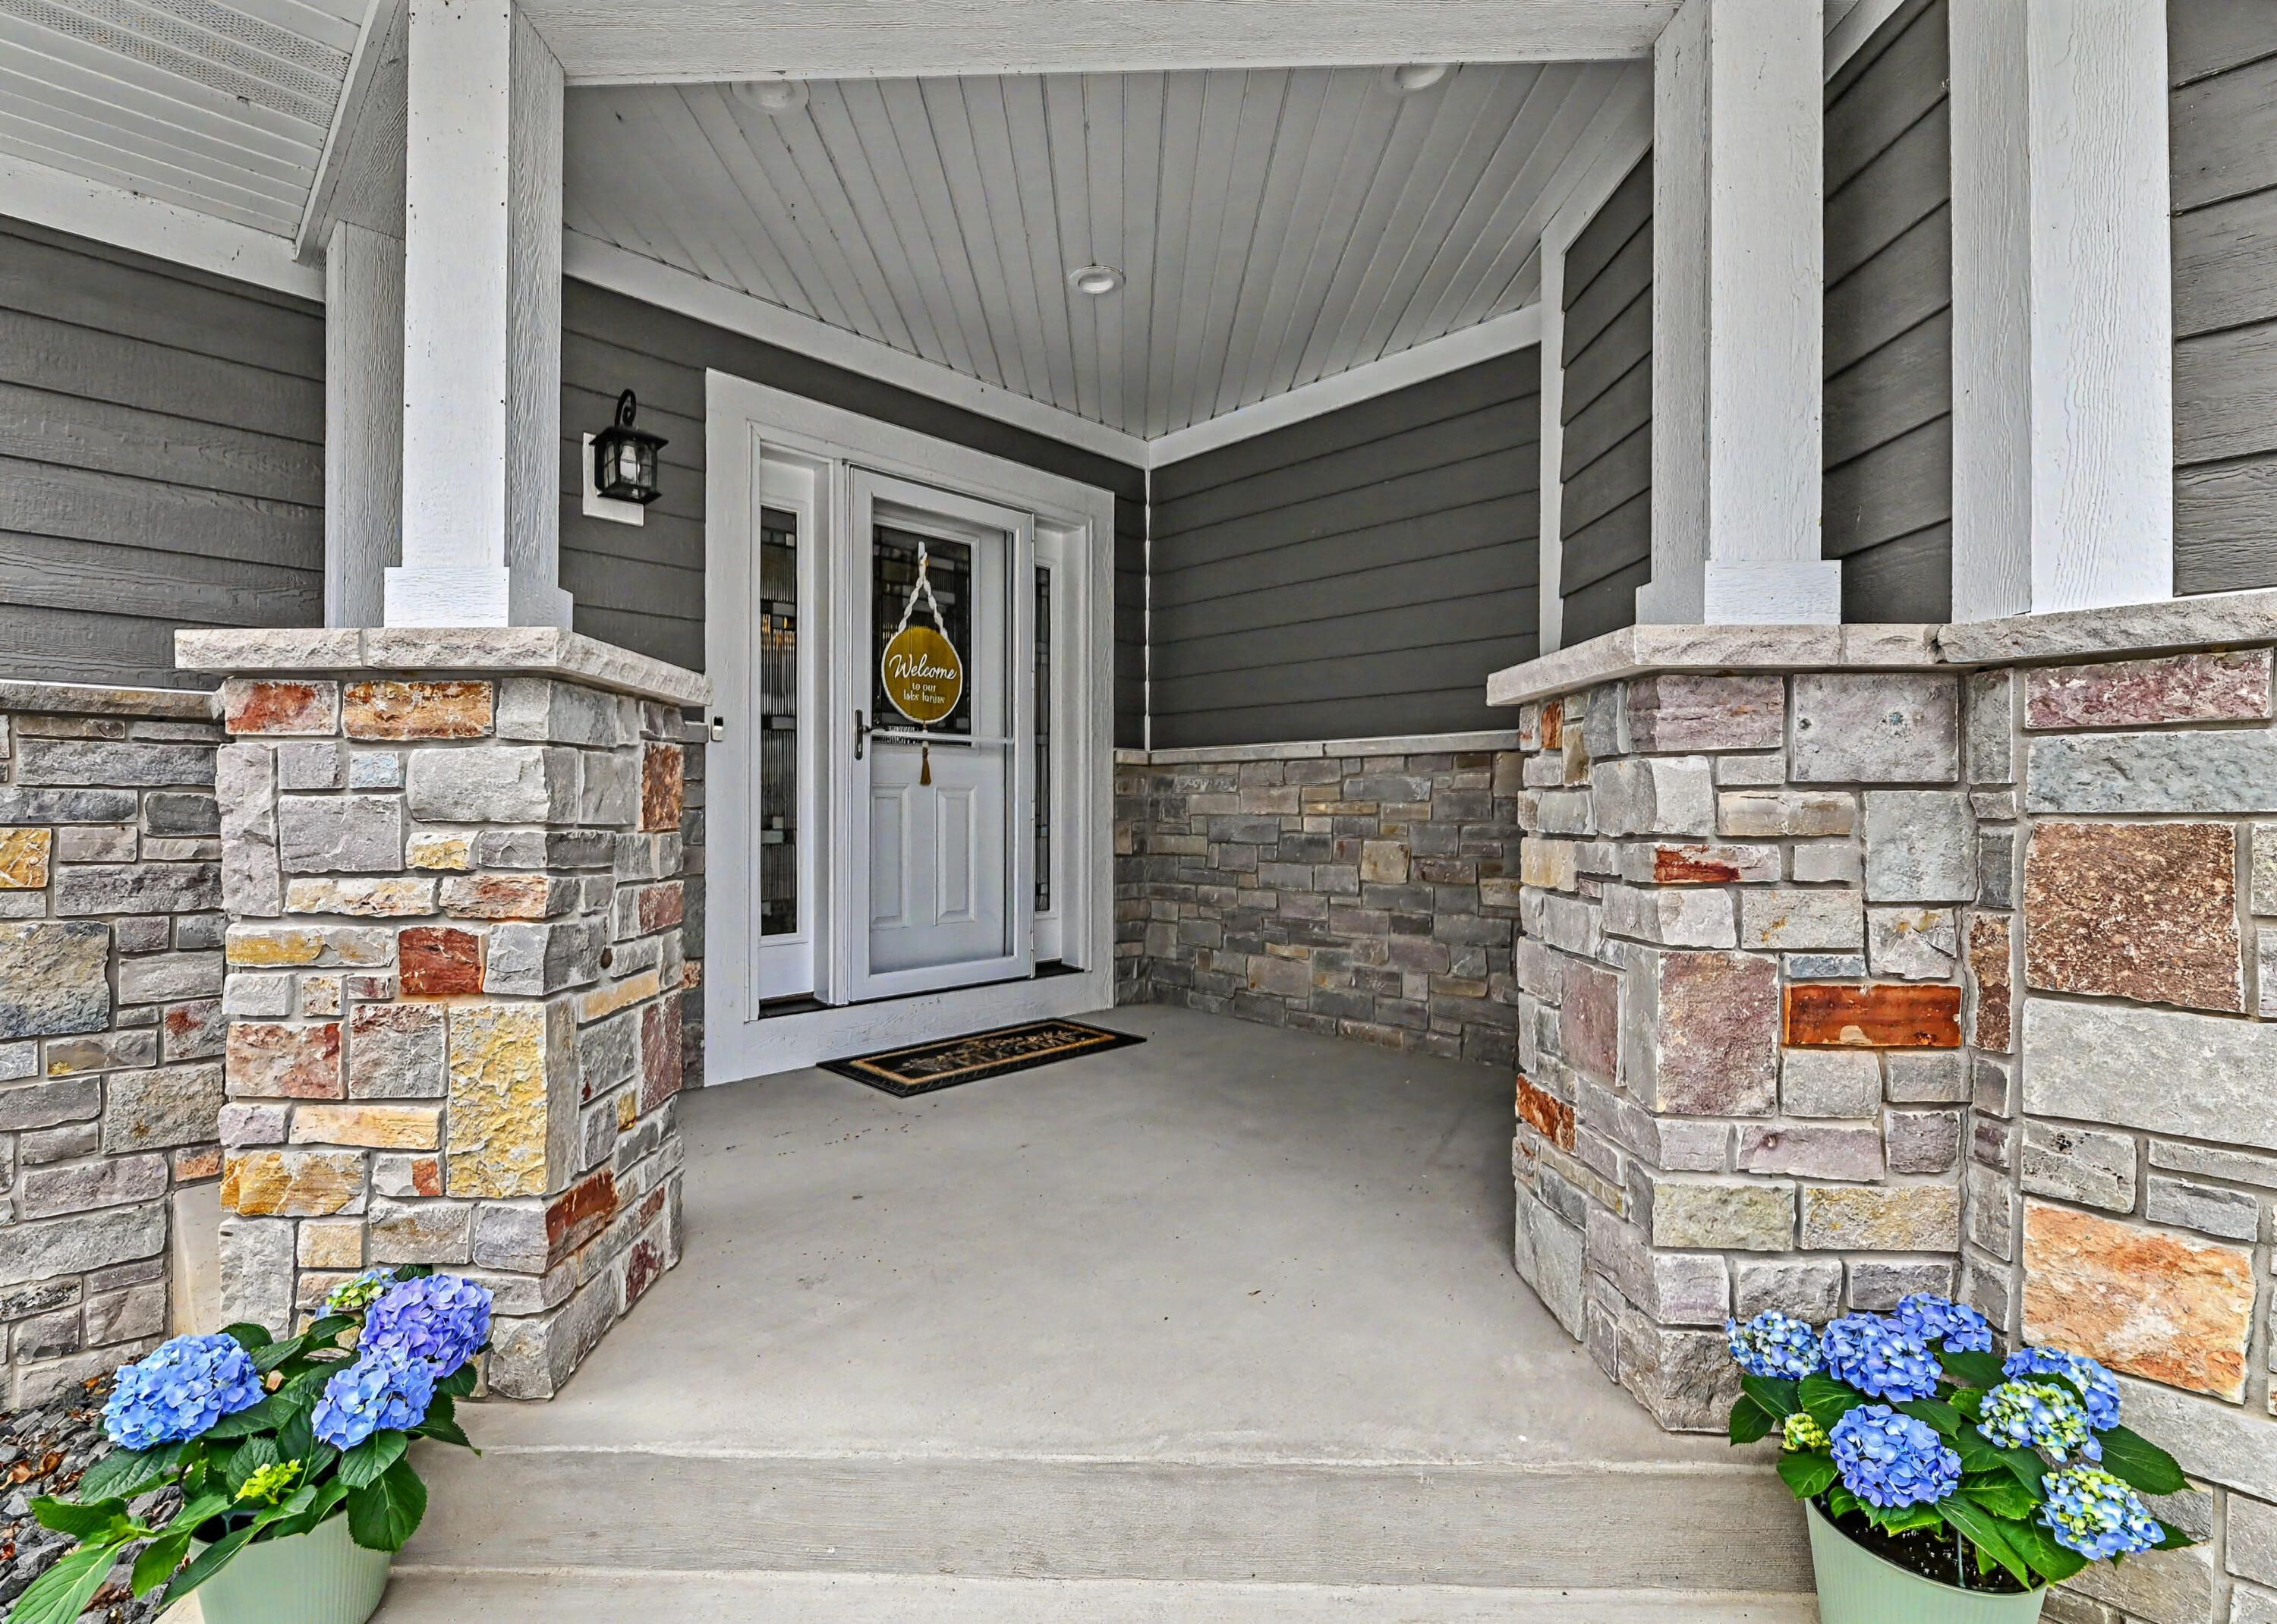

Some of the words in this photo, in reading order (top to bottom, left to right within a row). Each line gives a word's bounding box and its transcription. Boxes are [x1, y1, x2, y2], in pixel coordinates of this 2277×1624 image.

[889, 653, 957, 680] Welcome
[912, 682, 921, 691] to
[922, 684, 936, 692] our
